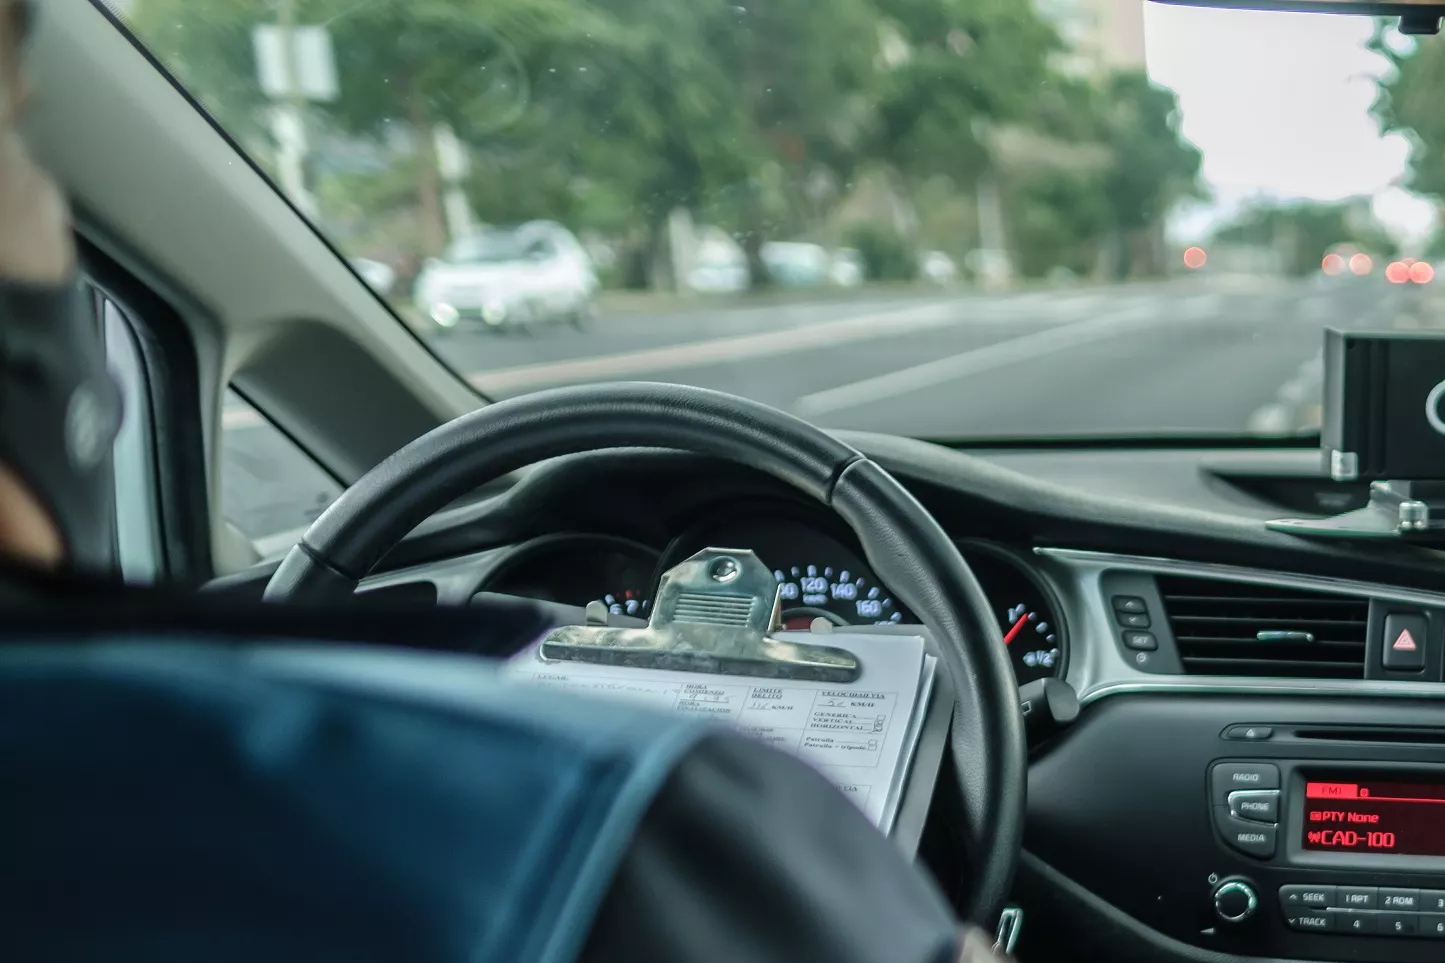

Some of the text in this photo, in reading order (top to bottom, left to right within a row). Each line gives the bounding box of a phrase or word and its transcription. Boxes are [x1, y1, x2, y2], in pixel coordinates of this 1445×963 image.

[800, 577, 829, 593] 120
[830, 583, 857, 600] 140
[1232, 773, 1259, 782] RADIO
[1241, 802, 1269, 811] PHONE
[1322, 811, 1379, 823] PTY None
[1237, 833, 1265, 843] MEDIA
[1321, 830, 1395, 848] CAD-100
[1302, 893, 1324, 902] SEEK
[1350, 895, 1368, 904] RPT
[1384, 896, 1413, 905] 2 RDM
[1438, 899, 1444, 907] 3
[1298, 917, 1326, 927] TRACK
[1353, 920, 1360, 928] 4
[1395, 922, 1401, 930] 5
[1437, 923, 1443, 931] 6
